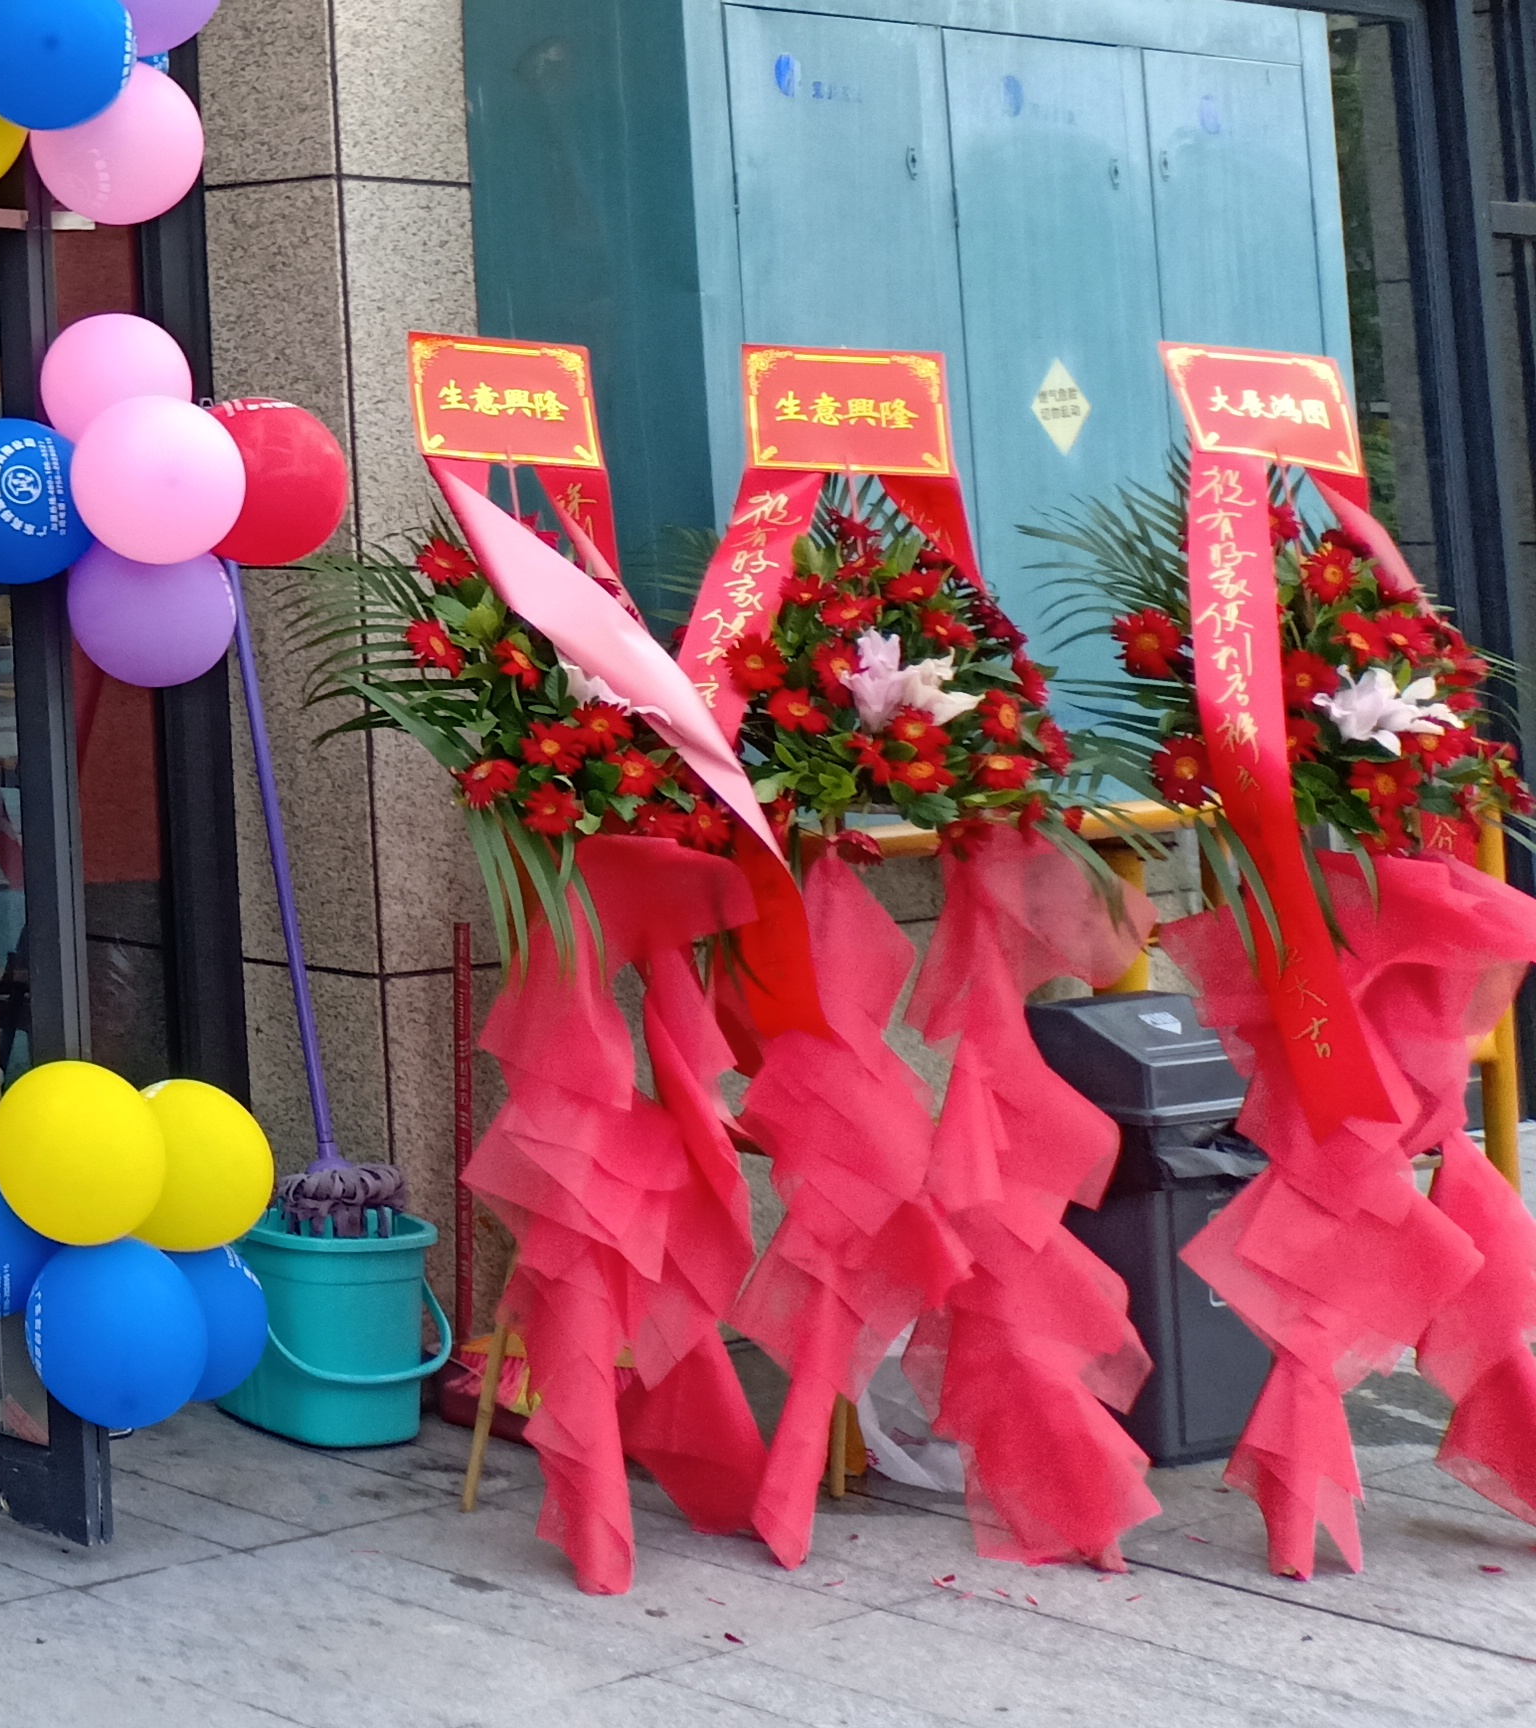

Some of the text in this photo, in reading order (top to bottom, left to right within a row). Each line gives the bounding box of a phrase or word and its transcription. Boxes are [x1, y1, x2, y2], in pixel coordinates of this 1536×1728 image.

[438, 379, 570, 422] 生意興隆
[775, 390, 919, 430] 生意興隆
